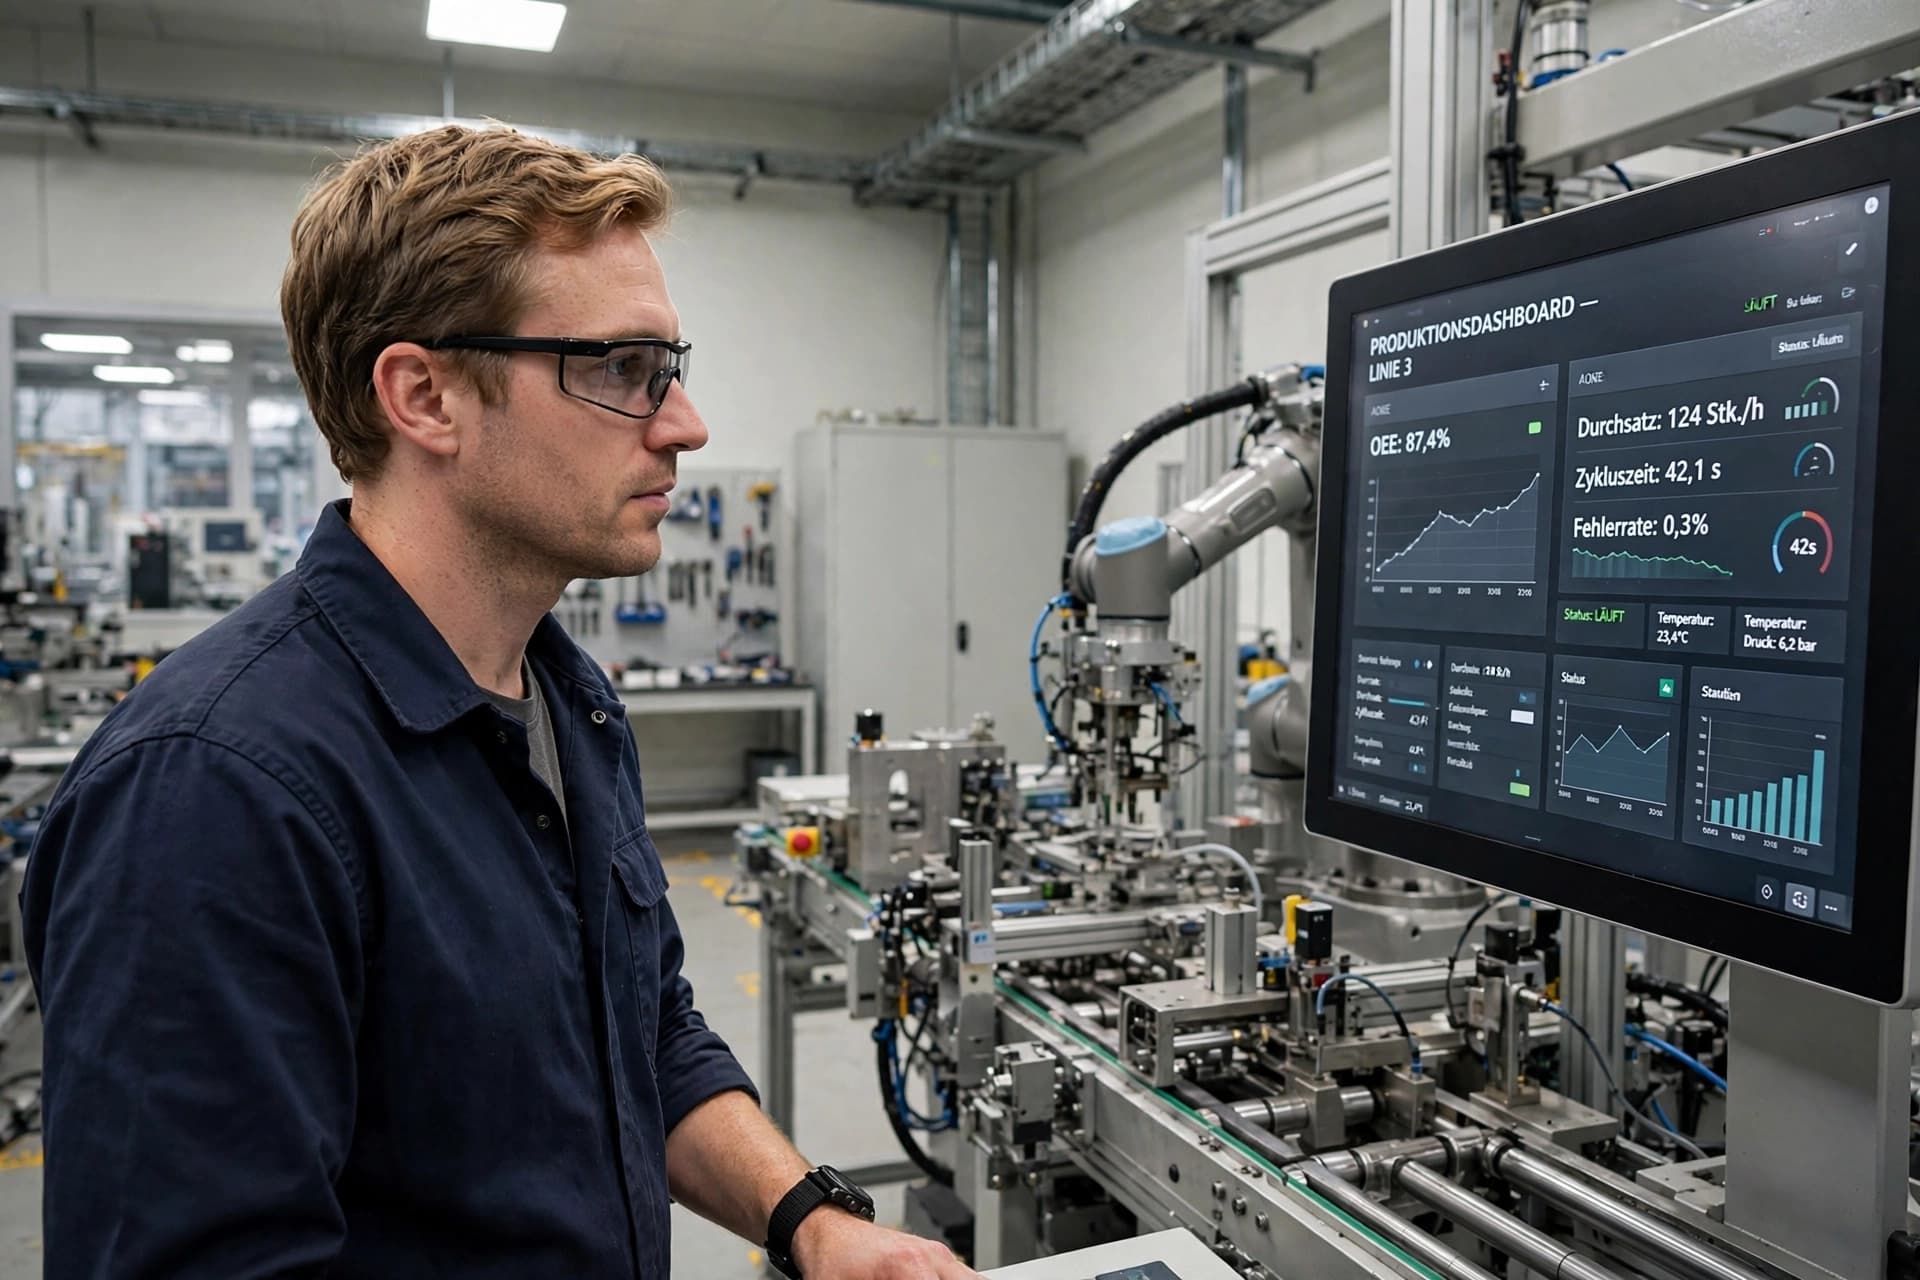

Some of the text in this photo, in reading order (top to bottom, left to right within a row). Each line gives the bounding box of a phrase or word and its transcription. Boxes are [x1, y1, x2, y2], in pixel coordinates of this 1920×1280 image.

[1370, 296, 1575, 356] PRODUKTIONSDASHBOARD
[1369, 357, 1412, 382] LINIE 3
[1577, 396, 1765, 438] Durchsatz: 124 Stk./h
[1370, 428, 1451, 456] OEE: 87,4%
[1574, 459, 1722, 493] Zykluszeit: 42,1 s
[1573, 512, 1710, 539] Fehlerrate: 0,3%
[1789, 538, 1818, 555] 42s
[1657, 611, 1715, 627] Temperatur:
[1744, 614, 1807, 632] Temperatur:
[1656, 630, 1689, 645] 23,4°C
[1743, 634, 1817, 652] Druck: 6,2 bar
